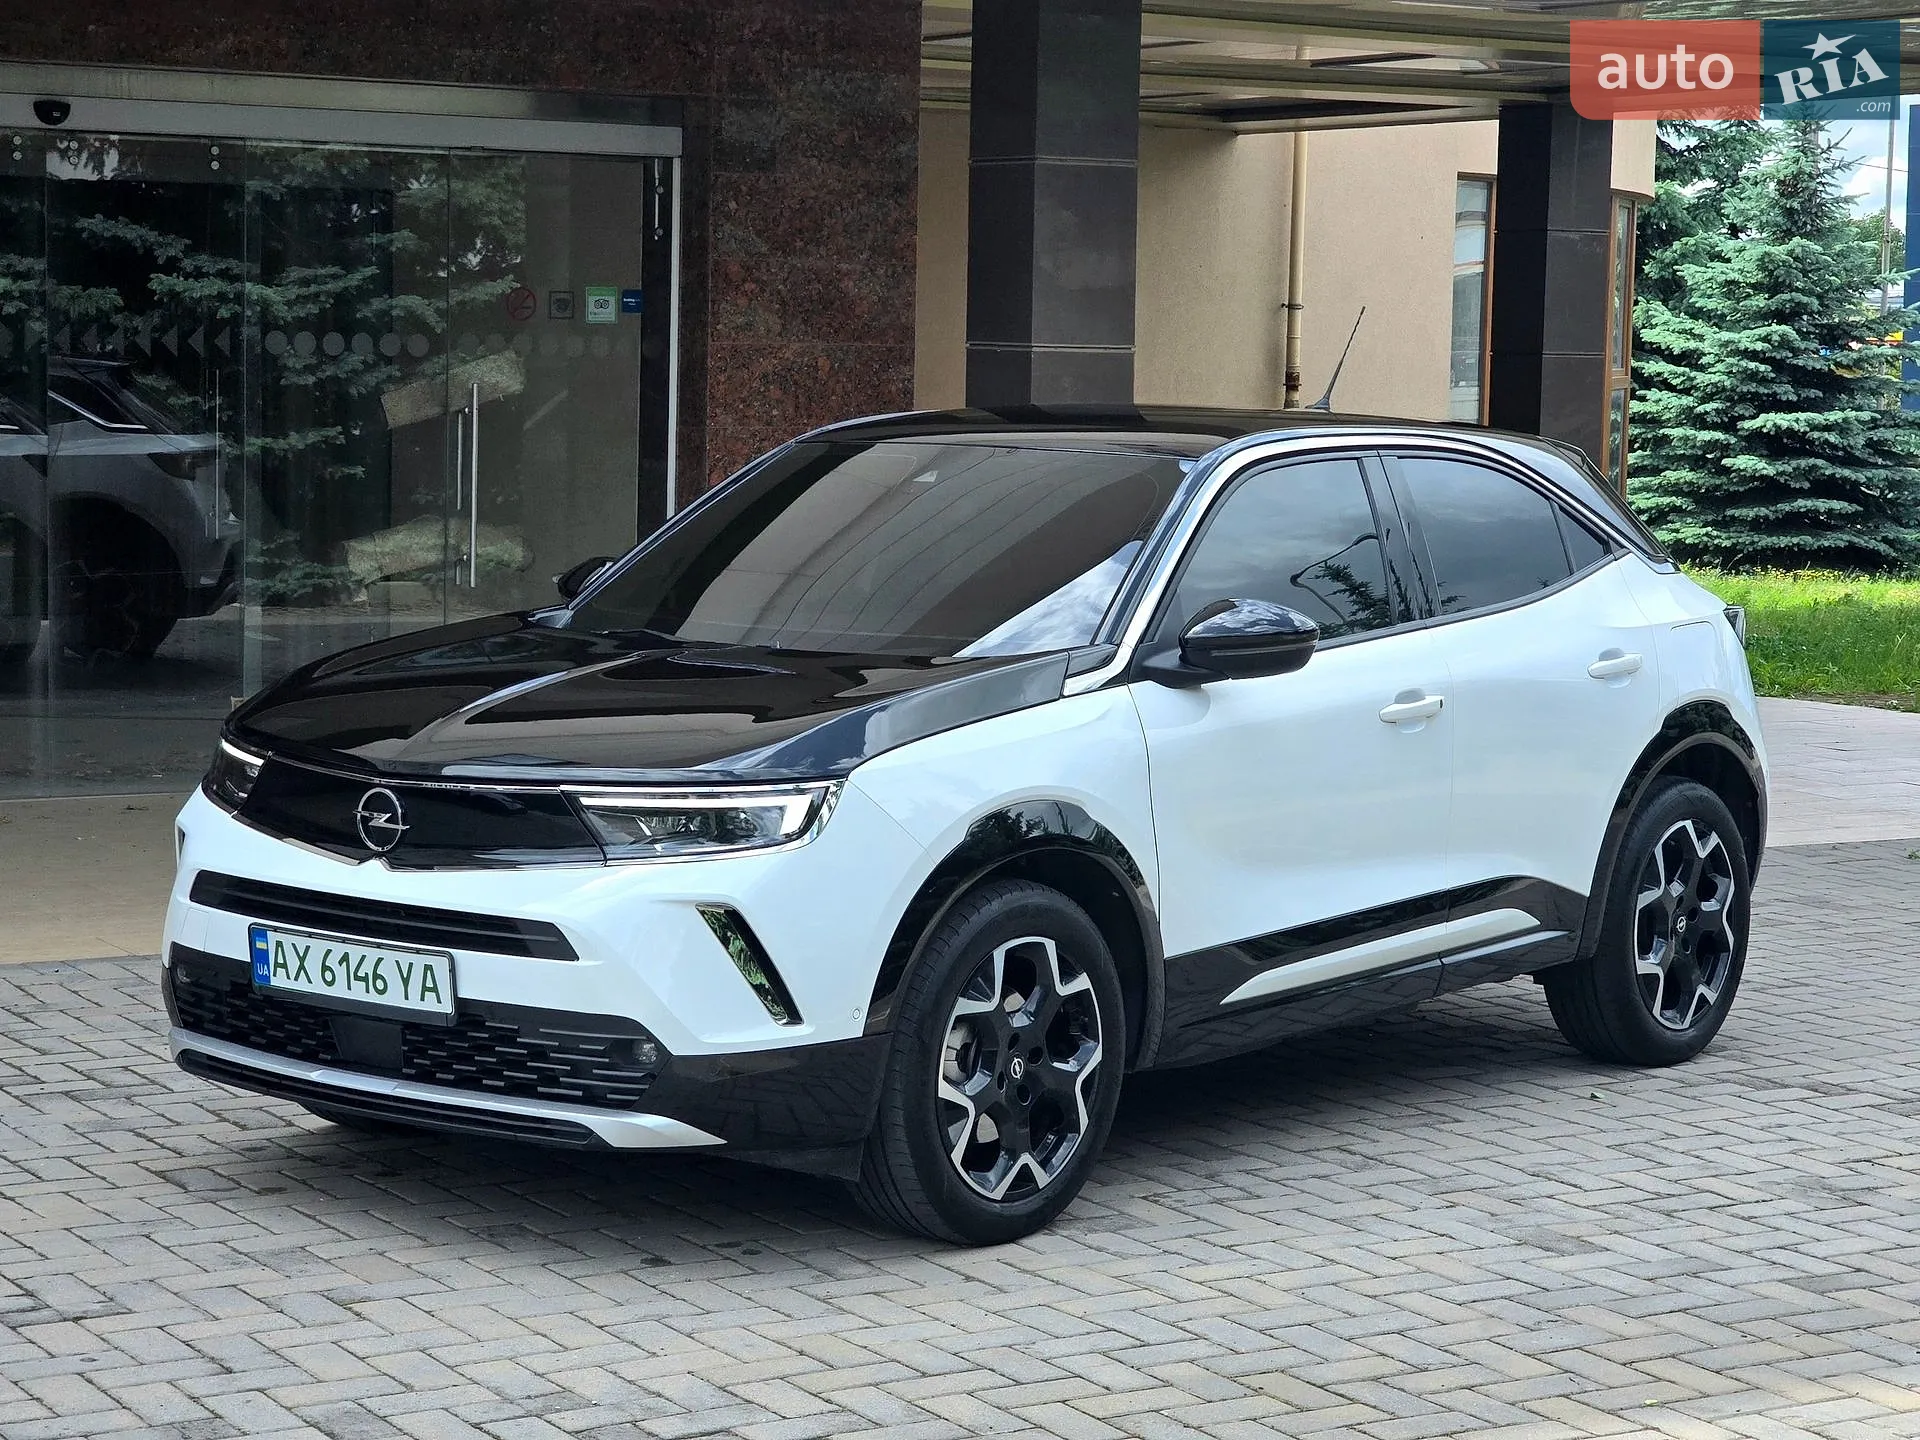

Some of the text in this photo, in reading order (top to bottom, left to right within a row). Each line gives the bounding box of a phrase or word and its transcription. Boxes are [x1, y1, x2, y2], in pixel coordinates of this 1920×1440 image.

[257, 963, 270, 977] UA
[272, 940, 442, 1004] AX 6146 YA
